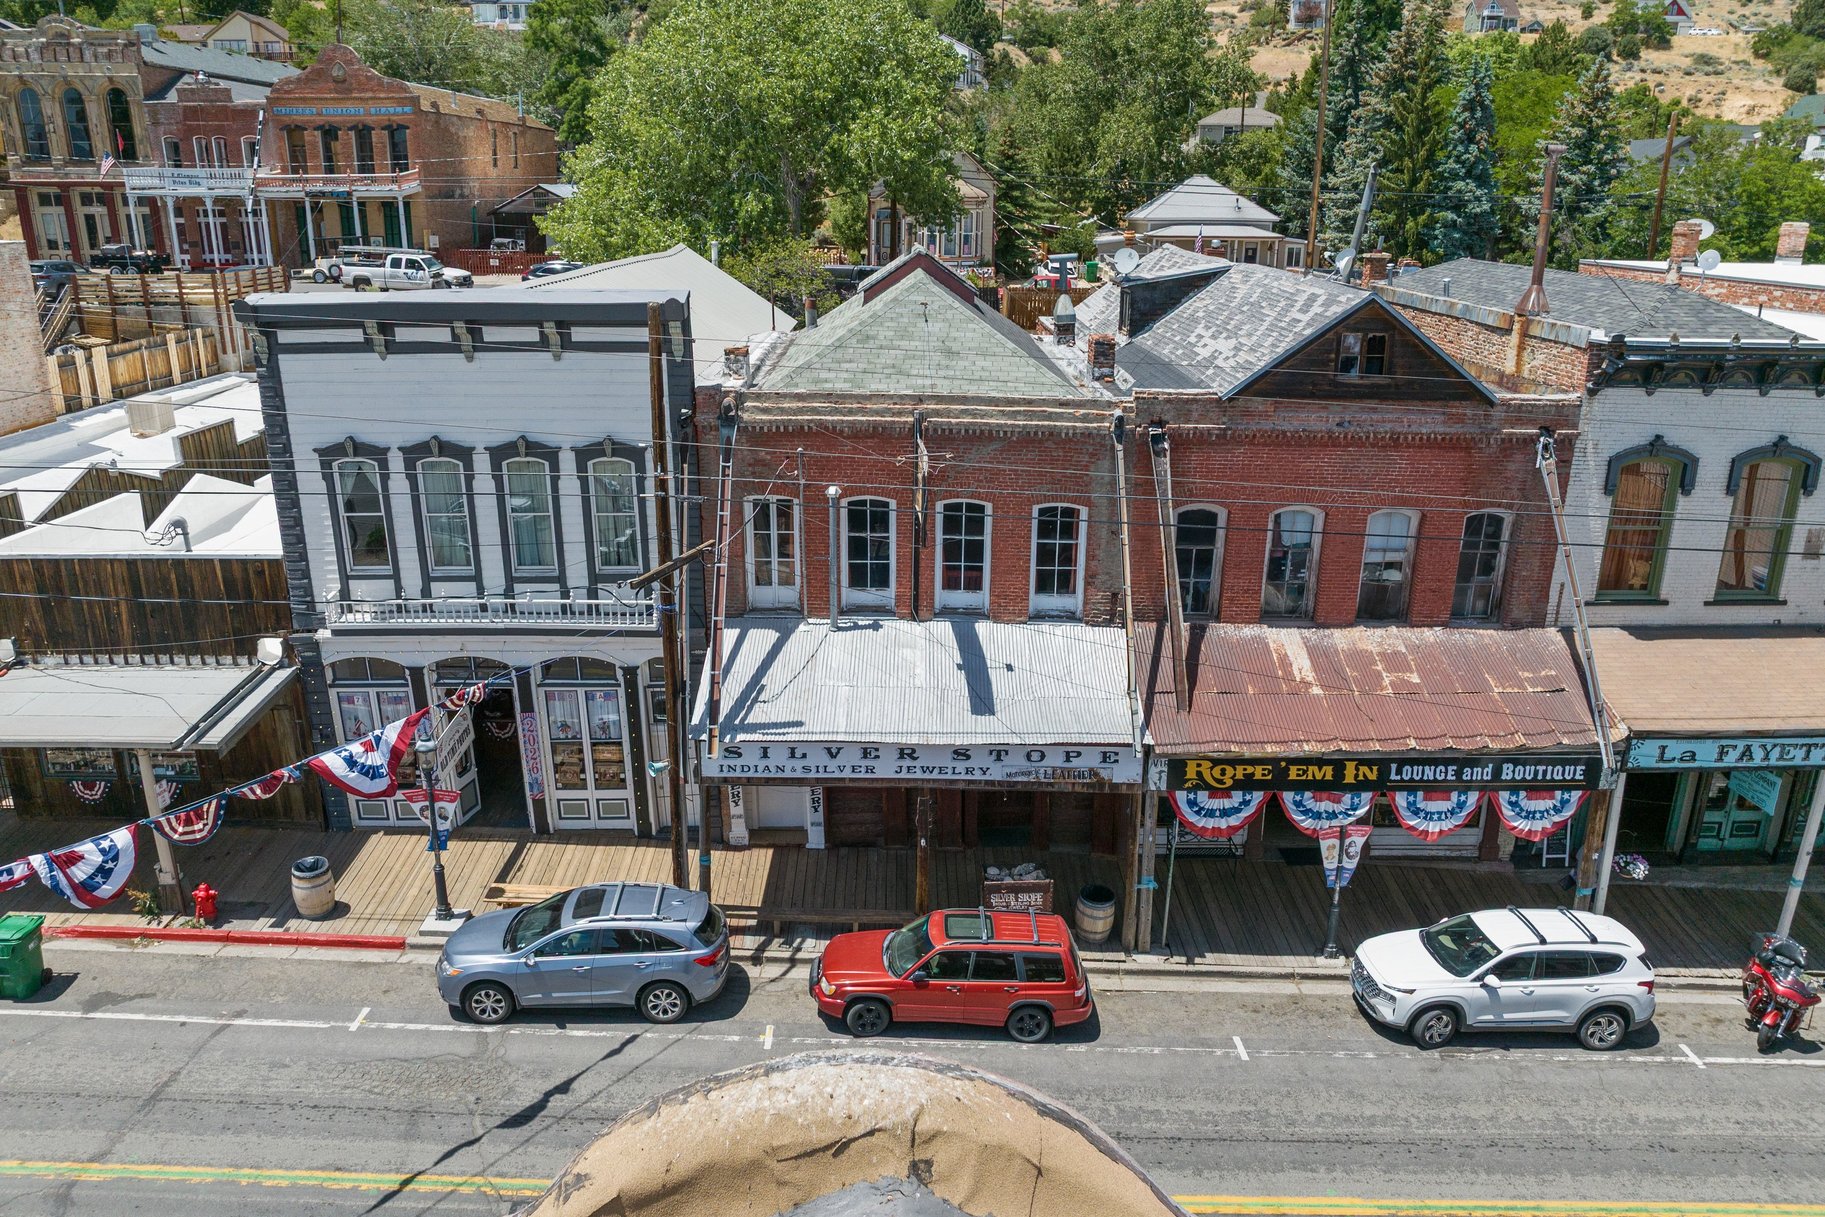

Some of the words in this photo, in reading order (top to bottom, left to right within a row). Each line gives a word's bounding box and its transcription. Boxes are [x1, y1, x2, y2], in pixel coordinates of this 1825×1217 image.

[527, 719, 539, 775] 2026
[723, 746, 920, 761] SILVER
[951, 747, 1120, 764] STOPE
[1655, 744, 1697, 764] La
[718, 764, 786, 774] INDIAN
[790, 766, 797, 774] &
[801, 764, 877, 775] SILVER
[894, 765, 993, 777] JEWELRY.
[1389, 763, 1457, 781] LOUNGE
[1462, 763, 1493, 781] and
[1501, 763, 1586, 781] BOUTIQUE
[991, 893, 1015, 901] SILVER
[1018, 893, 1043, 901] STOPE
